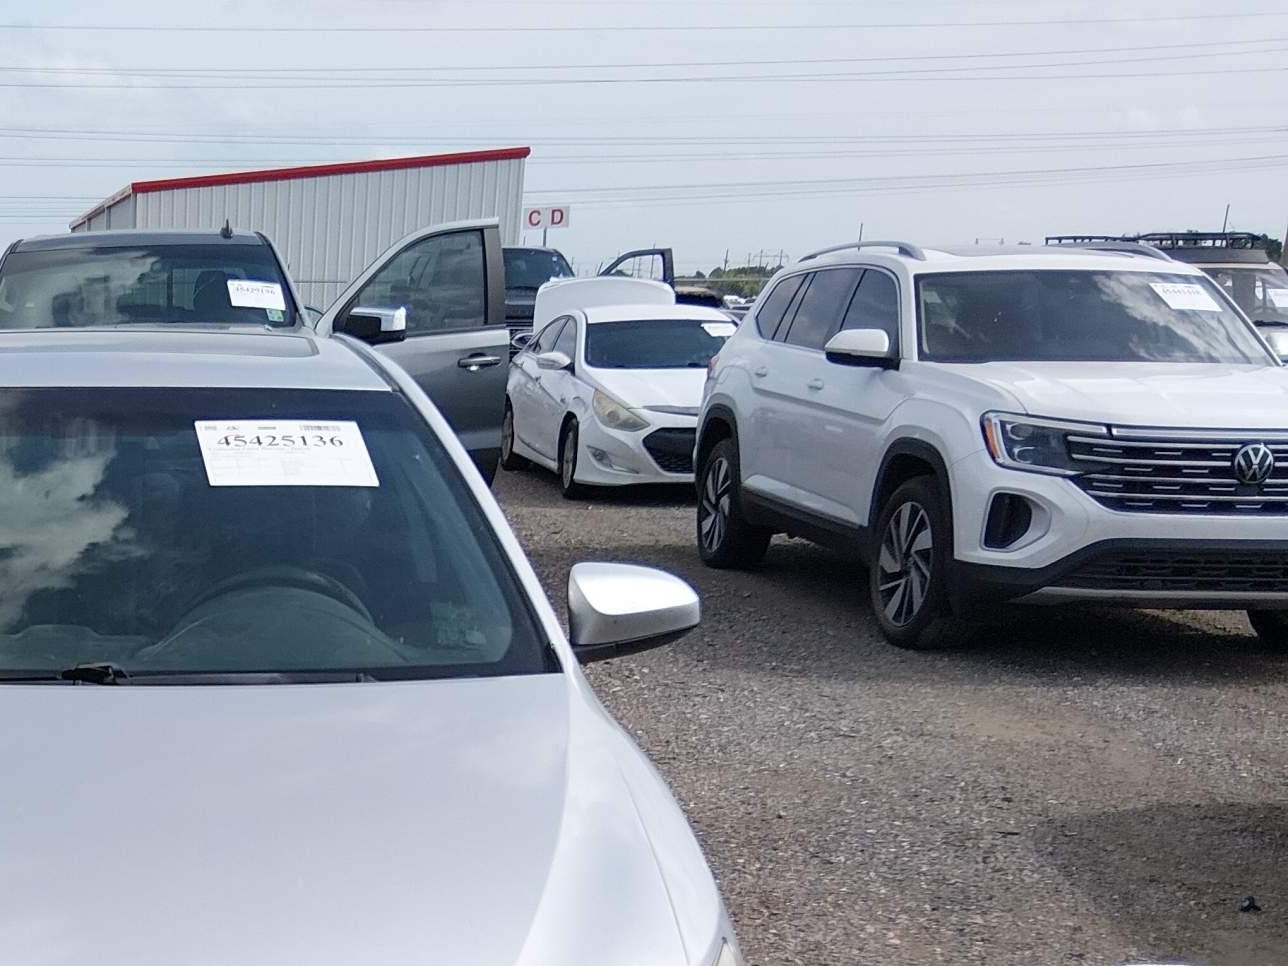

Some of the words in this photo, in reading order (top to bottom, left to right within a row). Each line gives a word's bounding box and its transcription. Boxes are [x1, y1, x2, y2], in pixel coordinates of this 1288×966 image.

[528, 209, 542, 227] C
[550, 208, 564, 226] D
[216, 434, 344, 448] 45425136
